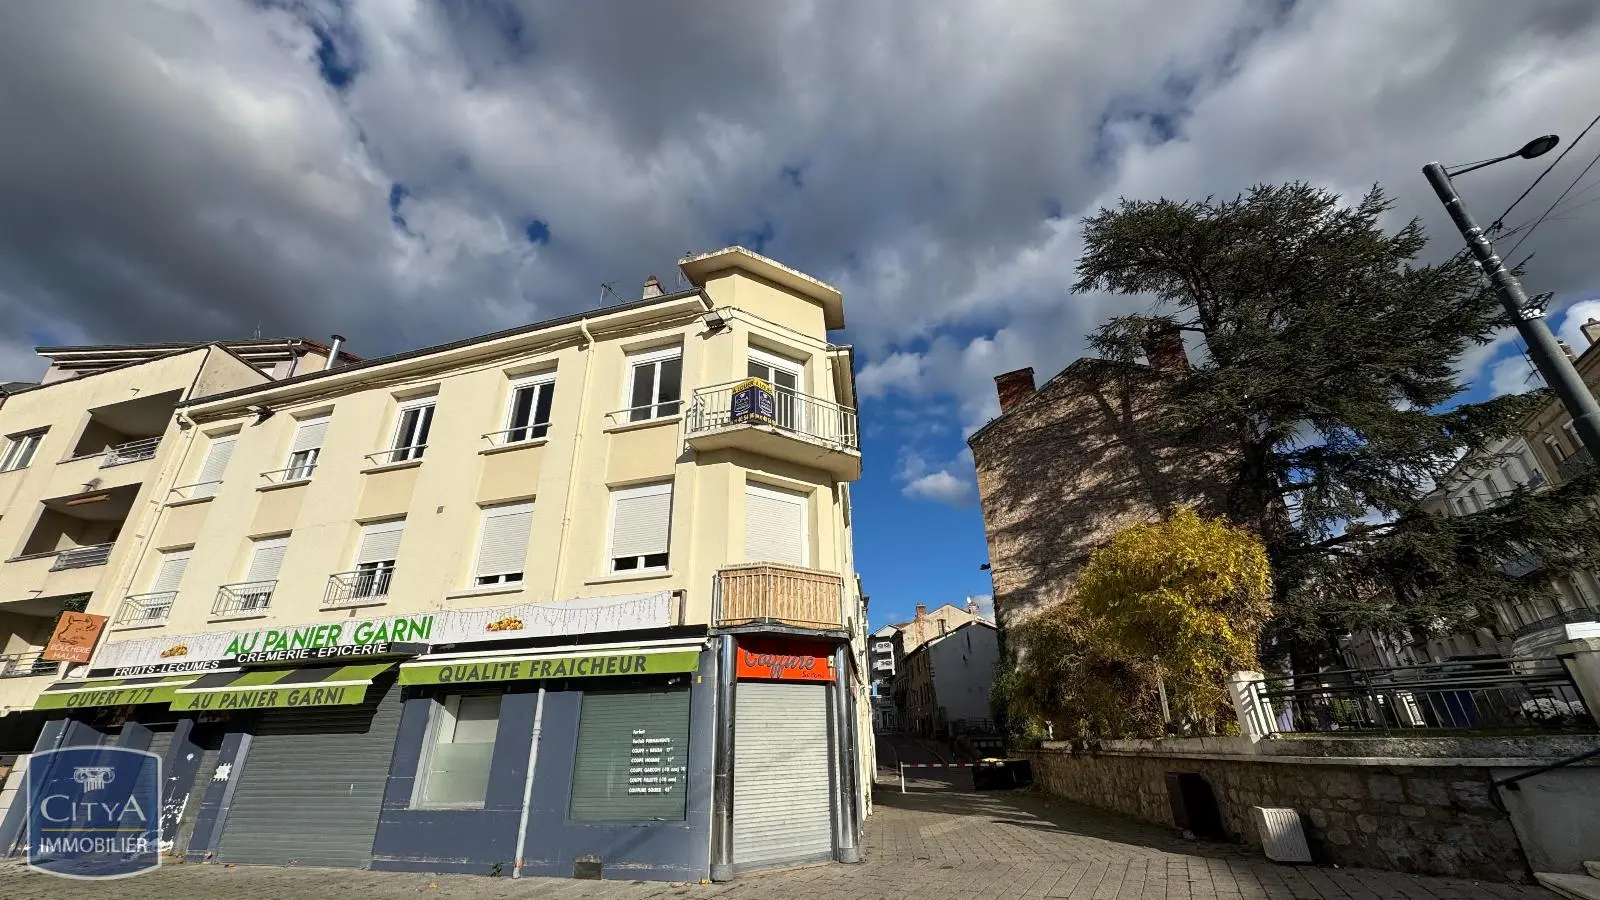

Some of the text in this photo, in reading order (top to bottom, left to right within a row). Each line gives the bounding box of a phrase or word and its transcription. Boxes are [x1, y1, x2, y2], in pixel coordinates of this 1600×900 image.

[224, 616, 434, 656] AU PANIER GARNI
[52, 652, 80, 660] HALAL
[438, 655, 647, 683] QUALITE FRAICHEUR
[67, 688, 154, 707] OUVERT 7/7
[188, 687, 345, 709] AU PANIER GARNI
